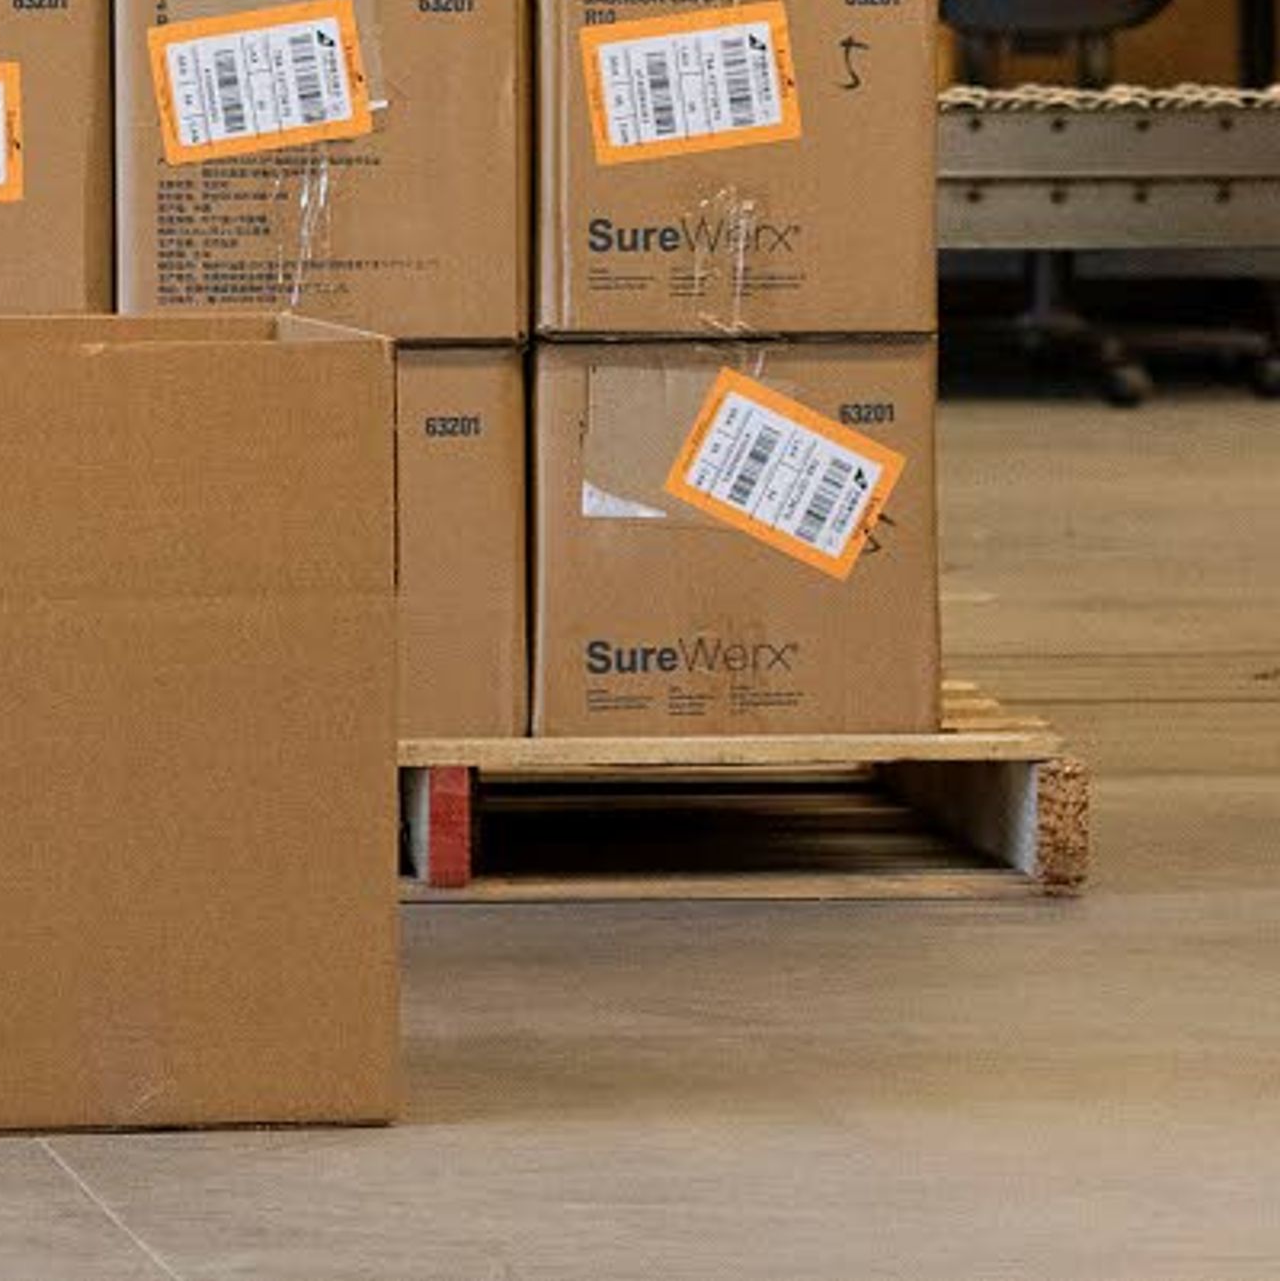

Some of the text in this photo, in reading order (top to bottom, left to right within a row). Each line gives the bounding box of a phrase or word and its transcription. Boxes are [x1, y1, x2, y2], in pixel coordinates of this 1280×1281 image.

[587, 218, 796, 253] SureWerx
[425, 416, 482, 437] 63201
[839, 403, 895, 424] 63201
[585, 637, 792, 675] SureWerx
